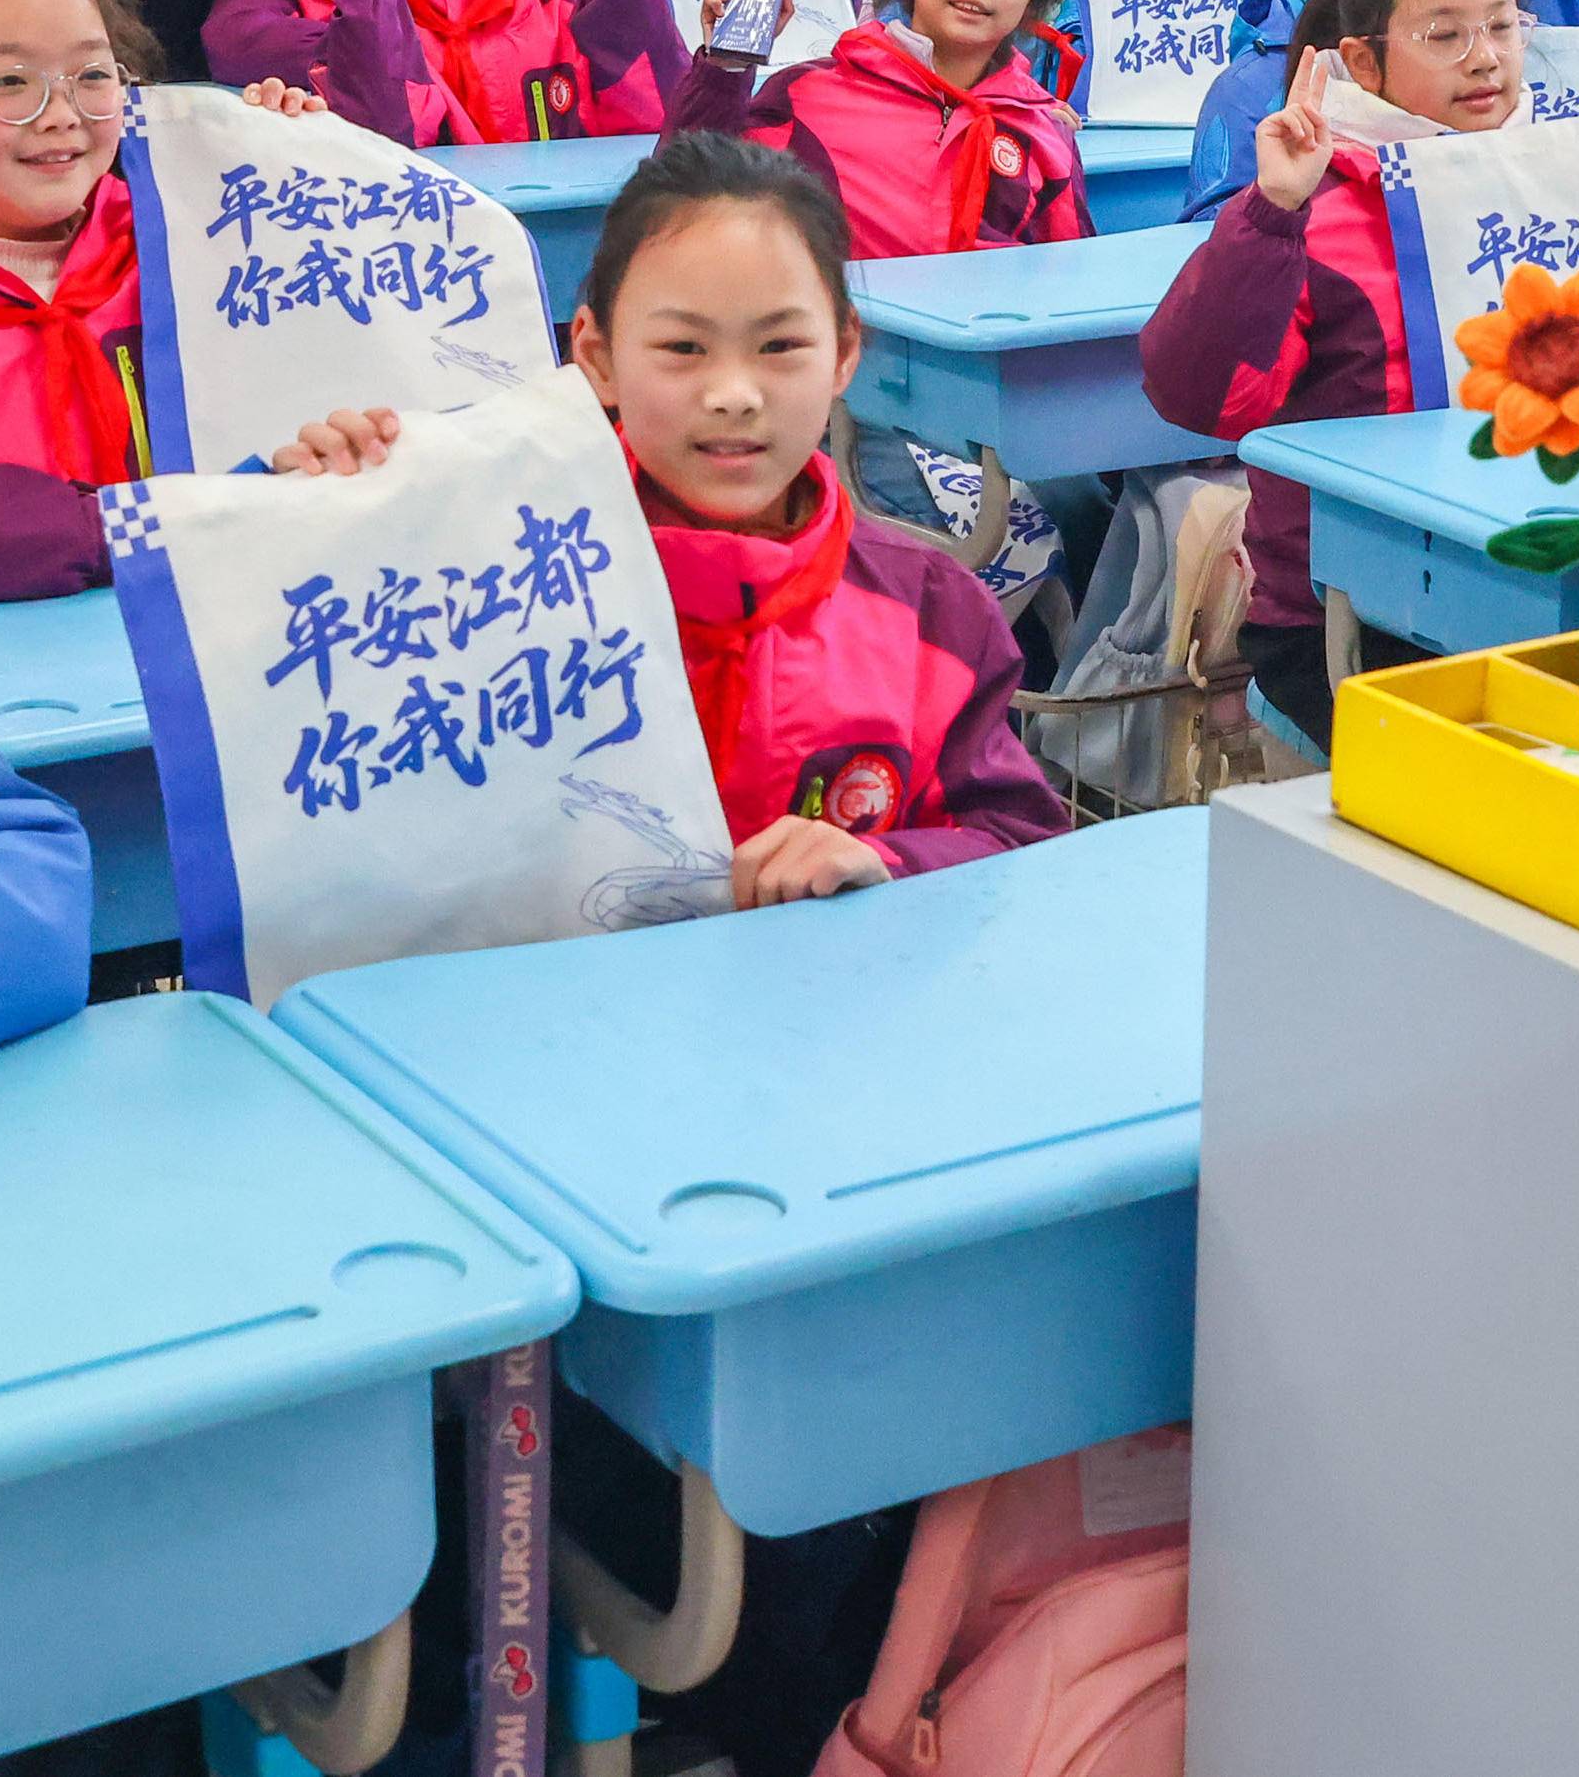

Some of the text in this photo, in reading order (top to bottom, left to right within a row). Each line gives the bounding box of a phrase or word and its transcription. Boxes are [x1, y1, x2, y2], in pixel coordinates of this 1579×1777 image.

[206, 161, 478, 243] 平安江都
[216, 242, 496, 329] 你我同行
[262, 504, 613, 701] 平安江都
[283, 626, 648, 820] 你我同行
[499, 1472, 533, 1627] KUROMI
